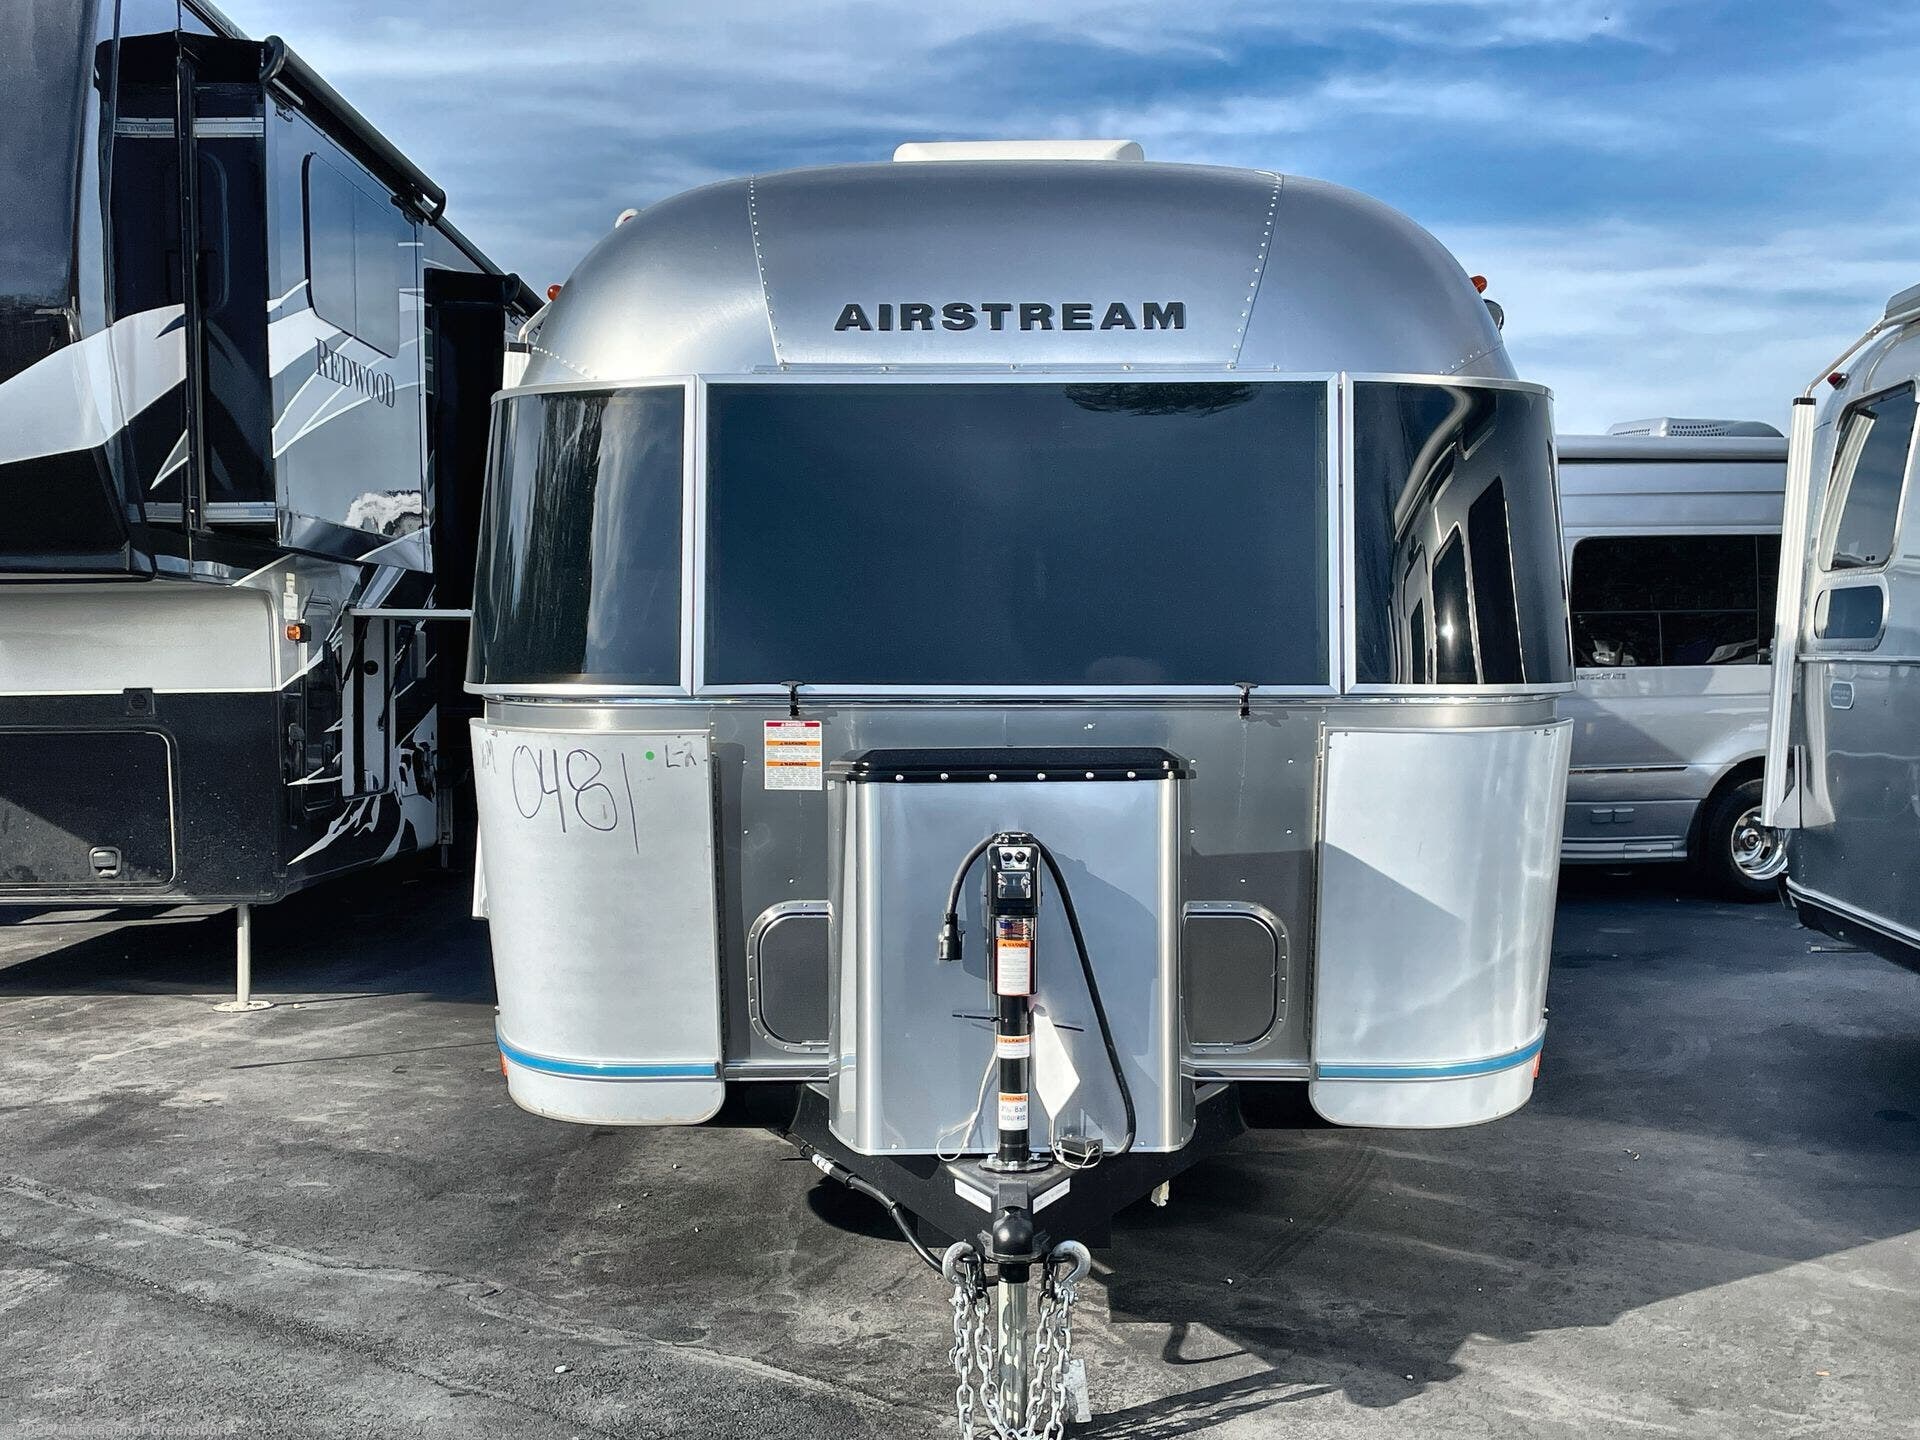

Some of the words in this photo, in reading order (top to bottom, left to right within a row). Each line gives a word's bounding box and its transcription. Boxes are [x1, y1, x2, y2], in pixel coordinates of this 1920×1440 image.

[834, 301, 1186, 332] AIRSTREAM
[315, 336, 395, 409] REDWOOD
[512, 744, 639, 855] 0481
